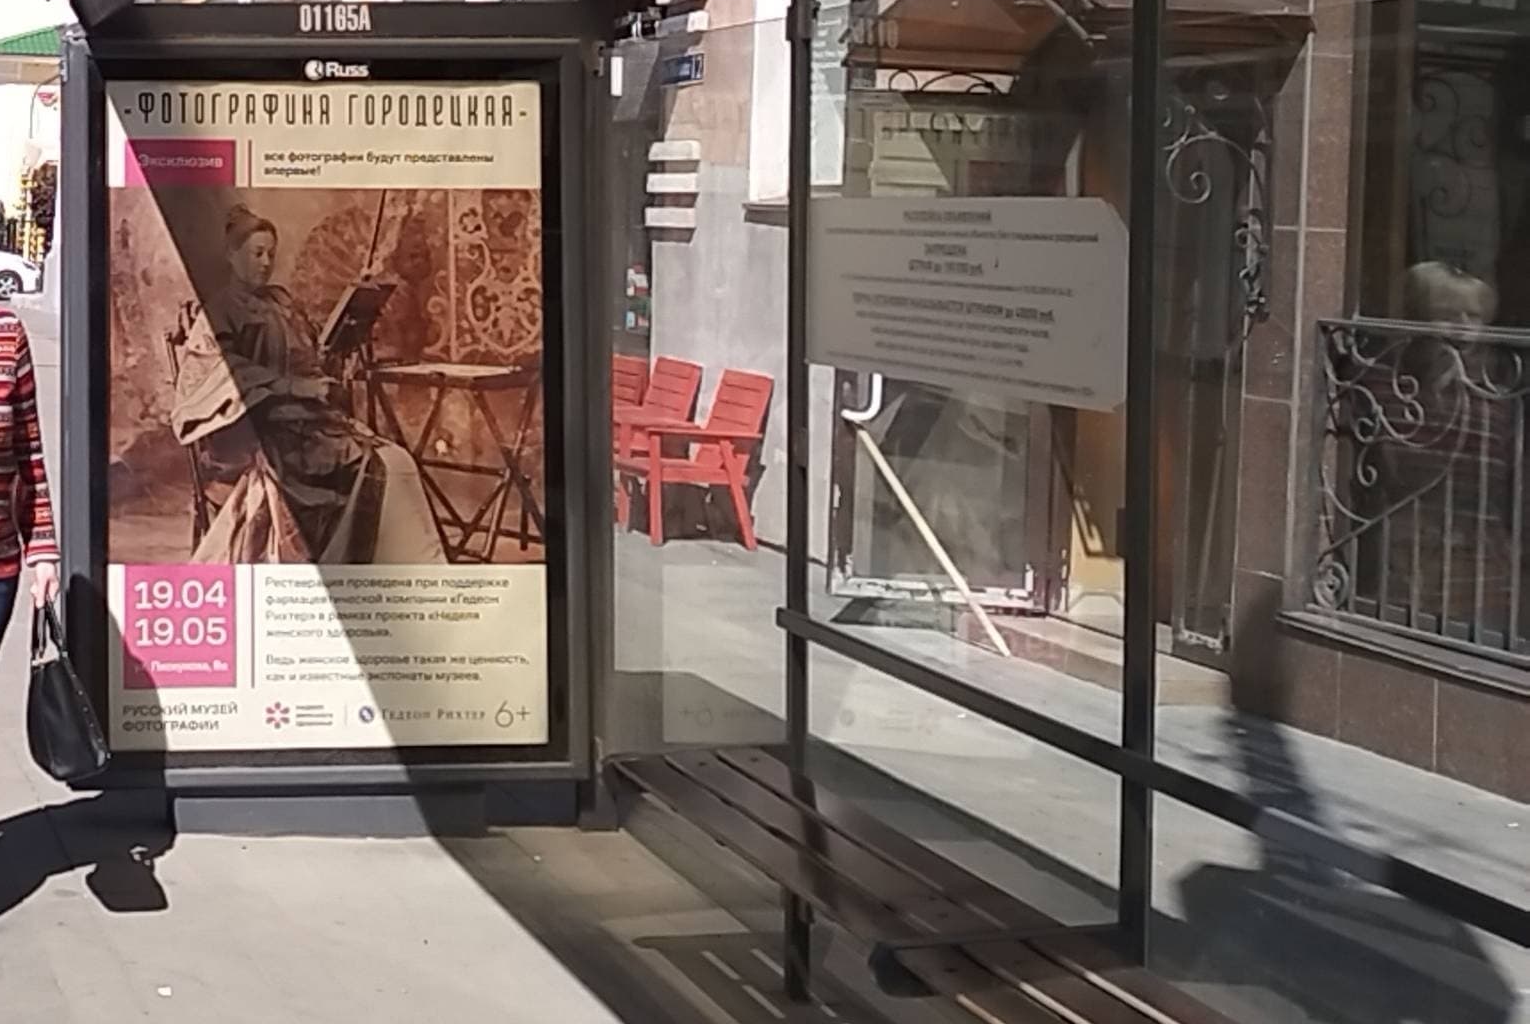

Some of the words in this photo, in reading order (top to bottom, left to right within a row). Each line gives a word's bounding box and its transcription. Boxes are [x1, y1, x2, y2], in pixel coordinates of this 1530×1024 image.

[325, 61, 369, 77] Russ
[138, 154, 223, 168] Эксклюзив
[264, 153, 285, 162] все
[288, 152, 364, 164] фотографии
[367, 151, 401, 165] будут
[404, 153, 494, 164] представлены
[347, 578, 412, 590] проведена
[415, 579, 439, 589] при
[441, 579, 509, 589] поддержке
[134, 580, 227, 609] 19.04
[386, 595, 446, 604] компании
[375, 611, 425, 623] проекта
[134, 616, 228, 646] 19.05
[413, 655, 447, 665] такая
[450, 656, 466, 664] же
[469, 655, 530, 666] ценность,
[265, 673, 285, 681] как
[122, 702, 187, 717] РУССКИЙ
[191, 701, 238, 715] МУЗЕЙ
[495, 699, 532, 728] 6+
[122, 719, 220, 733] ФОТОГРАФИИ
